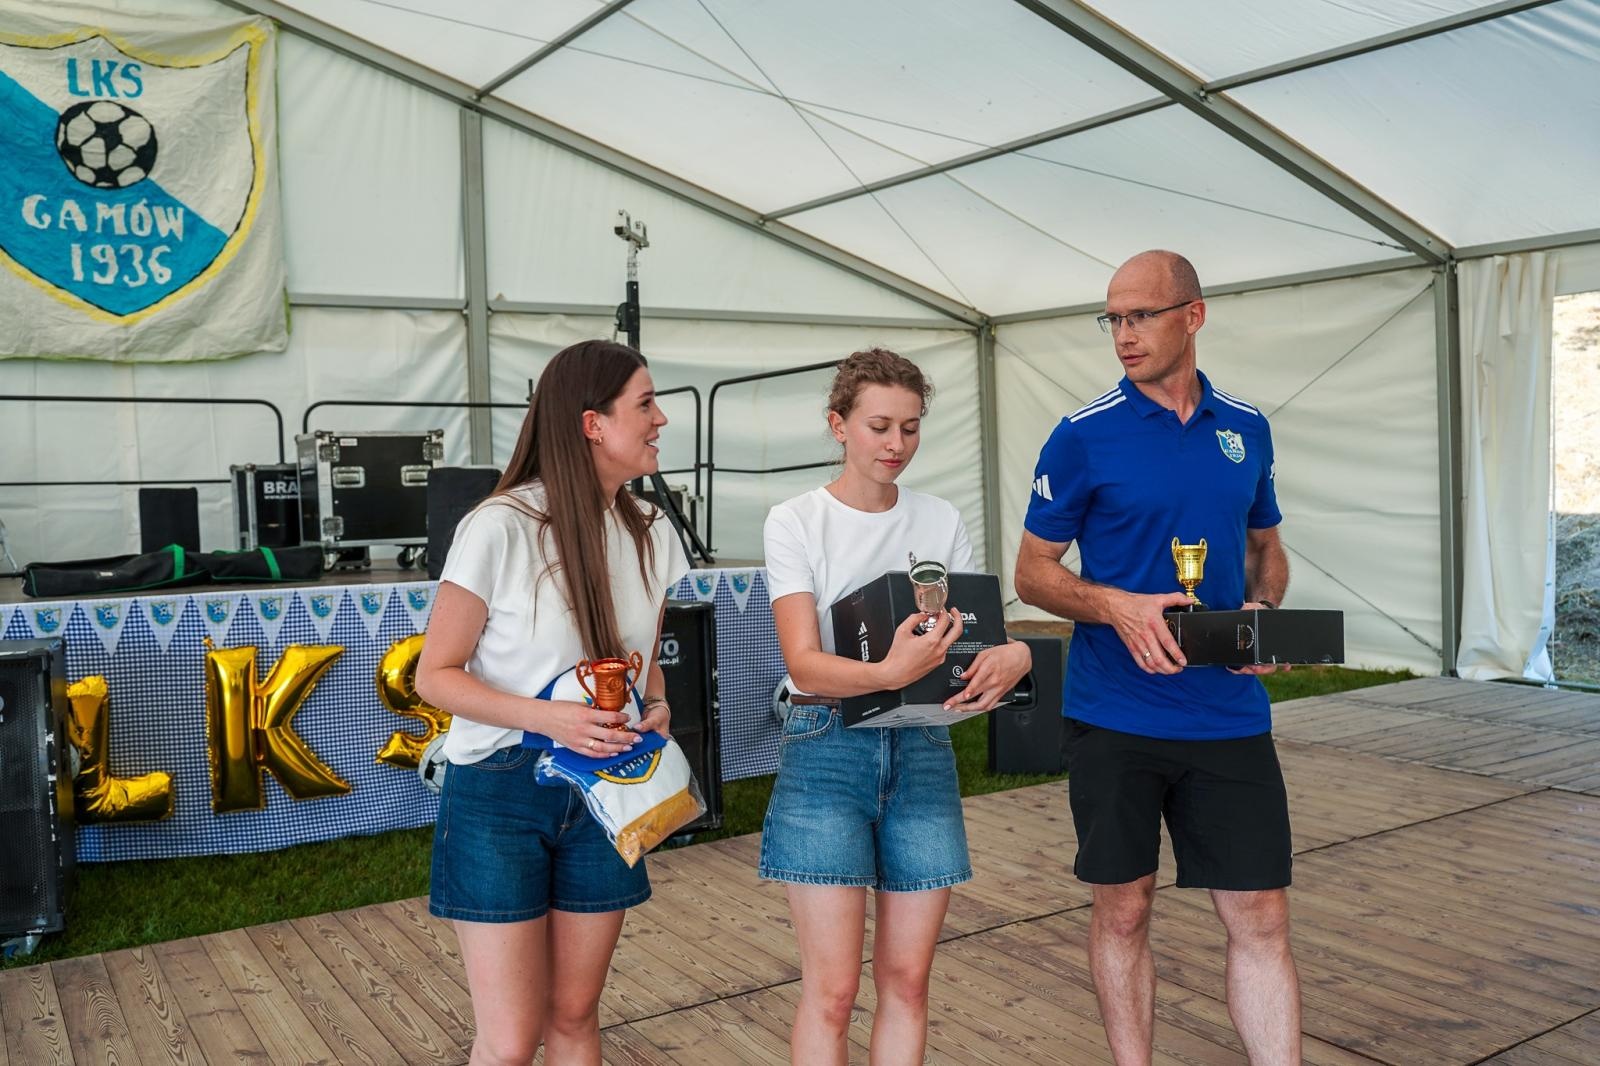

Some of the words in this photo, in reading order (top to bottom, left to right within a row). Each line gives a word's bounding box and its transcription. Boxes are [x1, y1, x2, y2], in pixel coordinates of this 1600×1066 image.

[66, 57, 144, 98] LKS
[21, 194, 185, 242] GAMÓW
[70, 243, 173, 288] 1936
